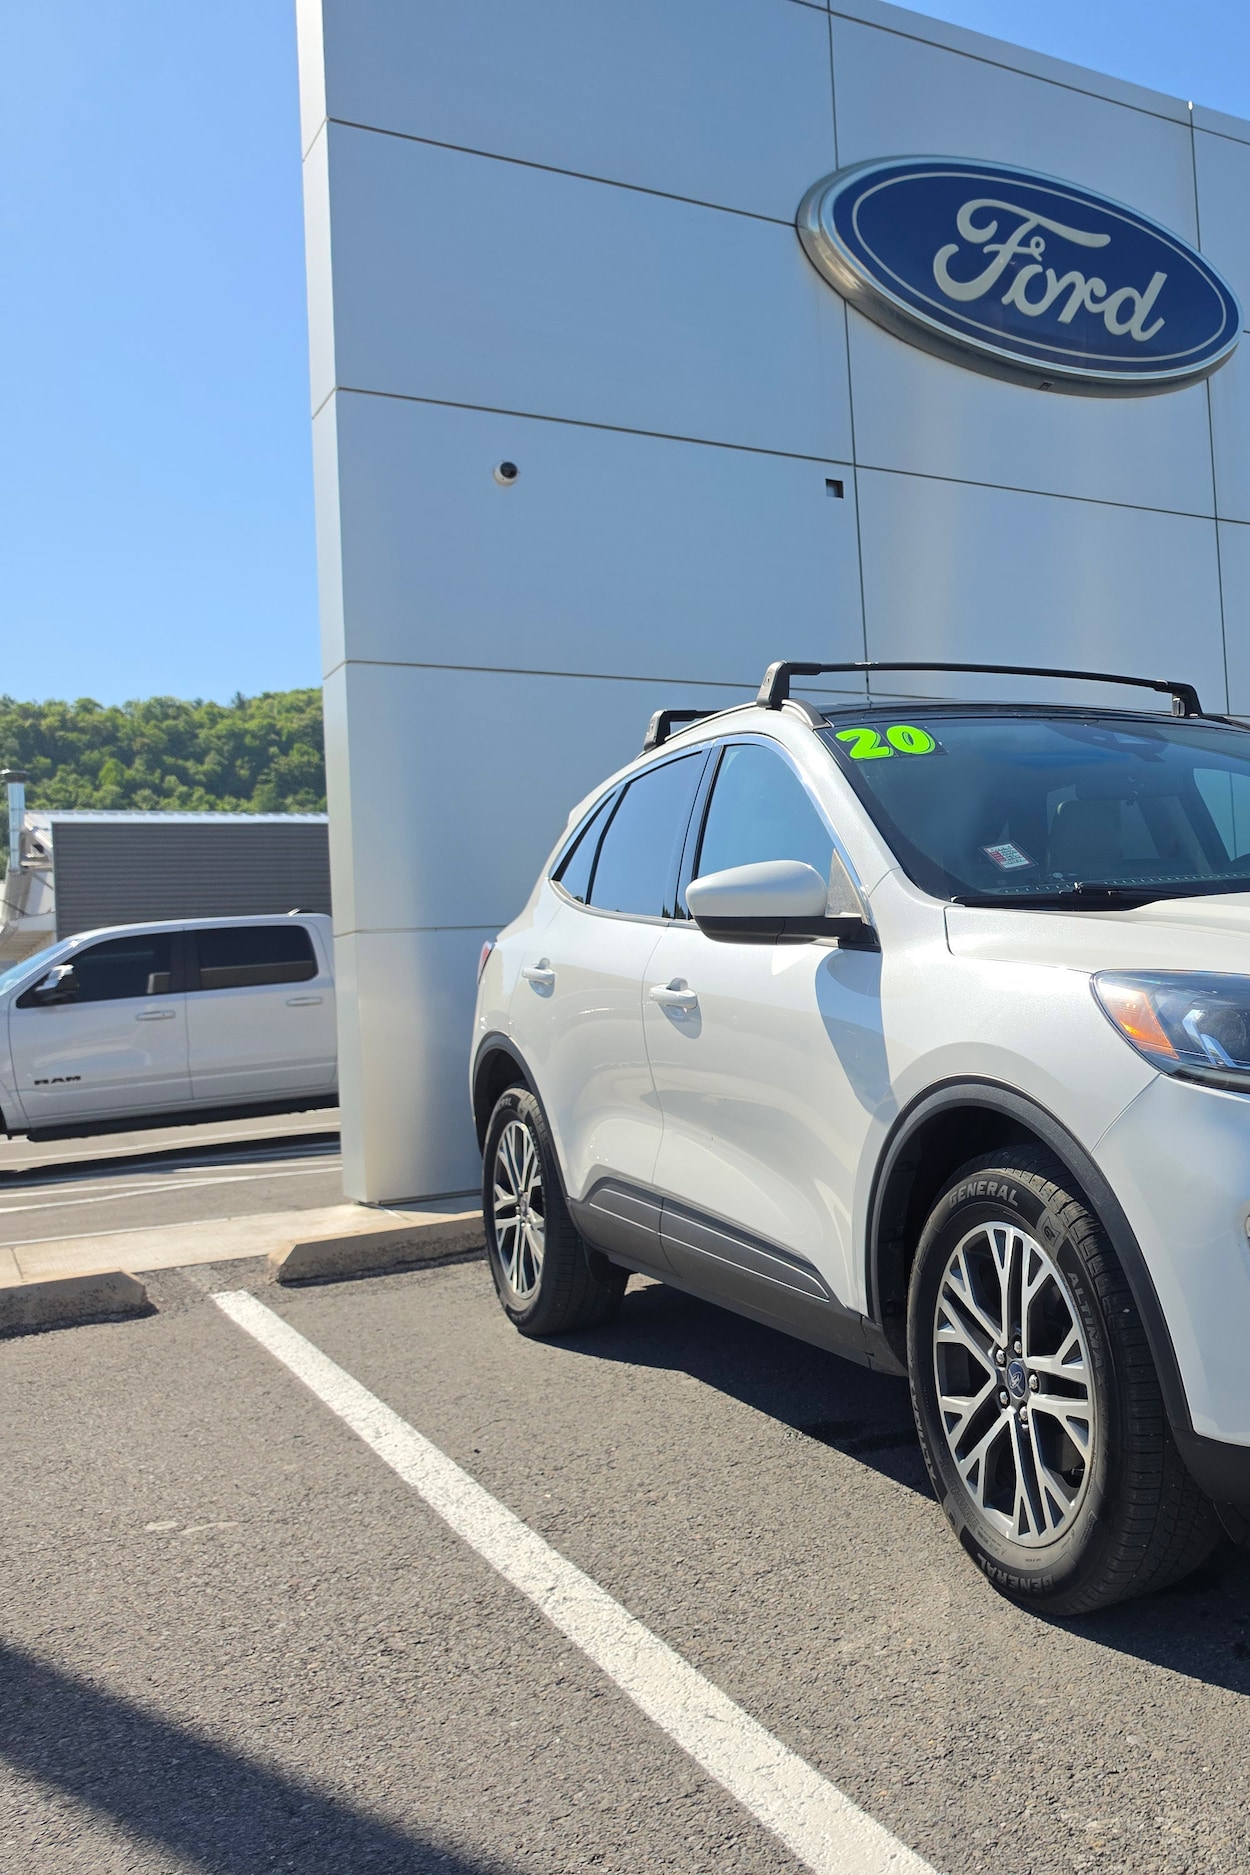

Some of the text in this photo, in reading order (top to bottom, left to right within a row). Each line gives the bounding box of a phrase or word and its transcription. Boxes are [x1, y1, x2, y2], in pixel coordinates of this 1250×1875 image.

[933, 198, 1168, 342] Ford
[835, 725, 936, 760] 20
[34, 1075, 81, 1086] RAM
[950, 1180, 1019, 1209] GENERAL
[977, 1553, 1054, 1593] GENERAL
